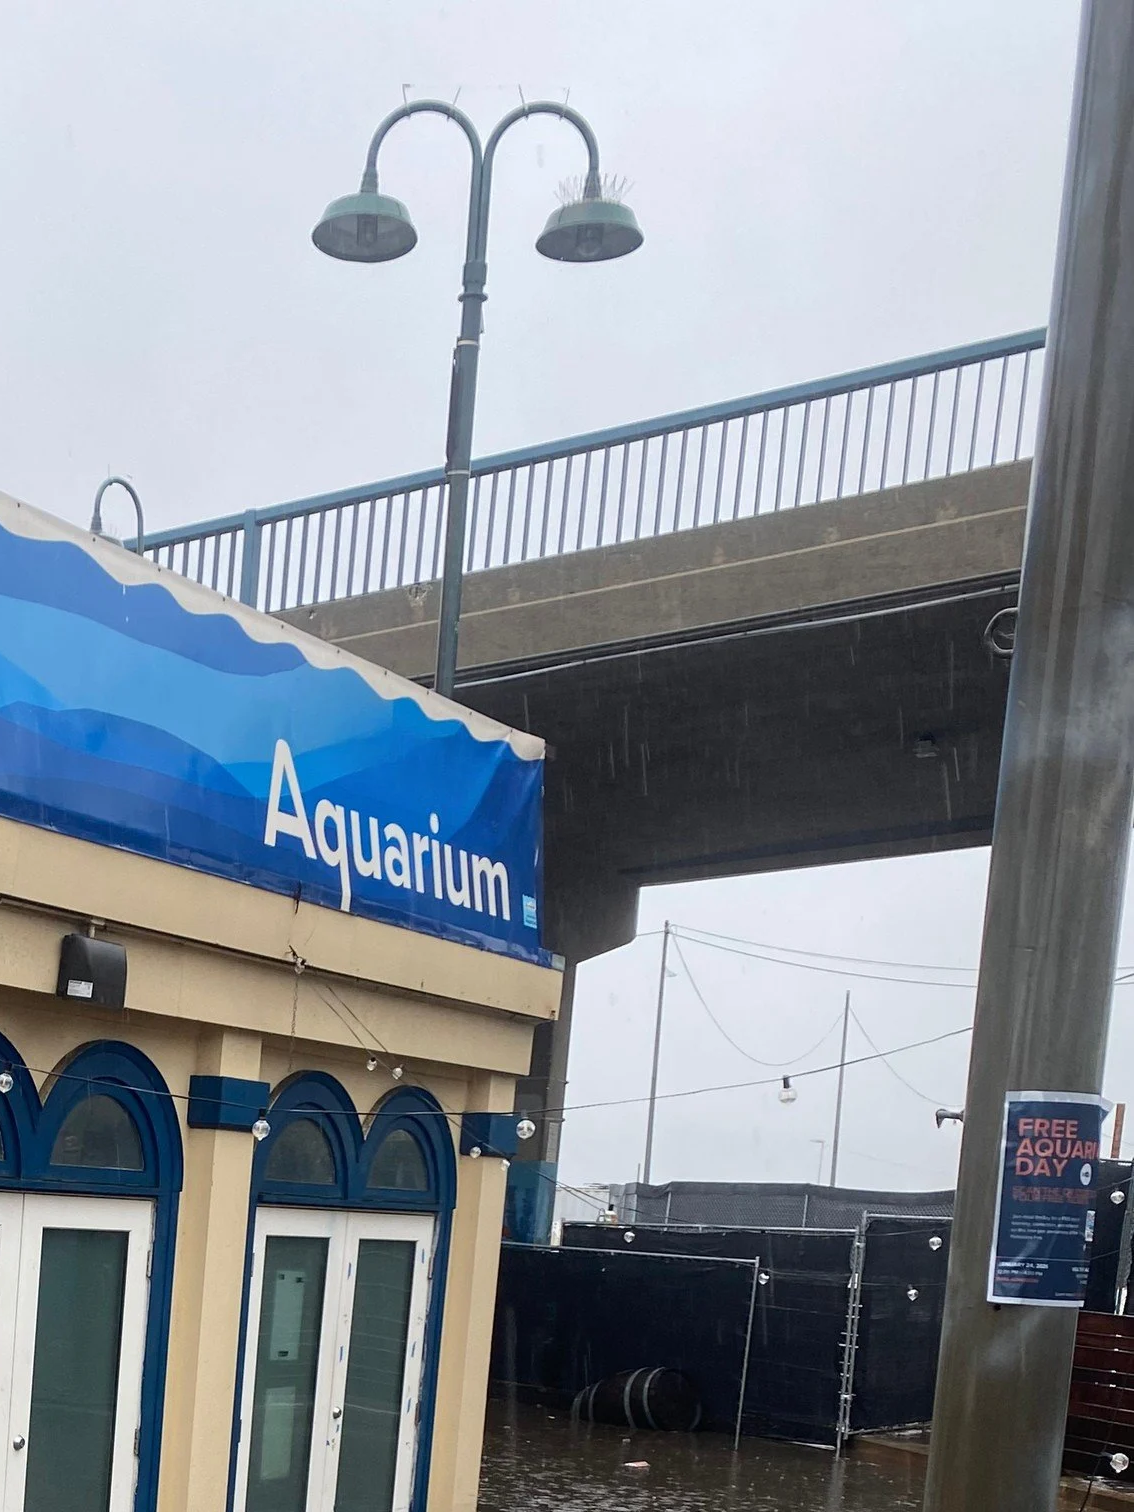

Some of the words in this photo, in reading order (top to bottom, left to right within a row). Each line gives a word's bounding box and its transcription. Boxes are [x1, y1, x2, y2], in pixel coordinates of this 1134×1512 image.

[263, 738, 511, 921] Aquarium
[1018, 1118, 1078, 1139] FREE
[1015, 1157, 1068, 1177] DAY
